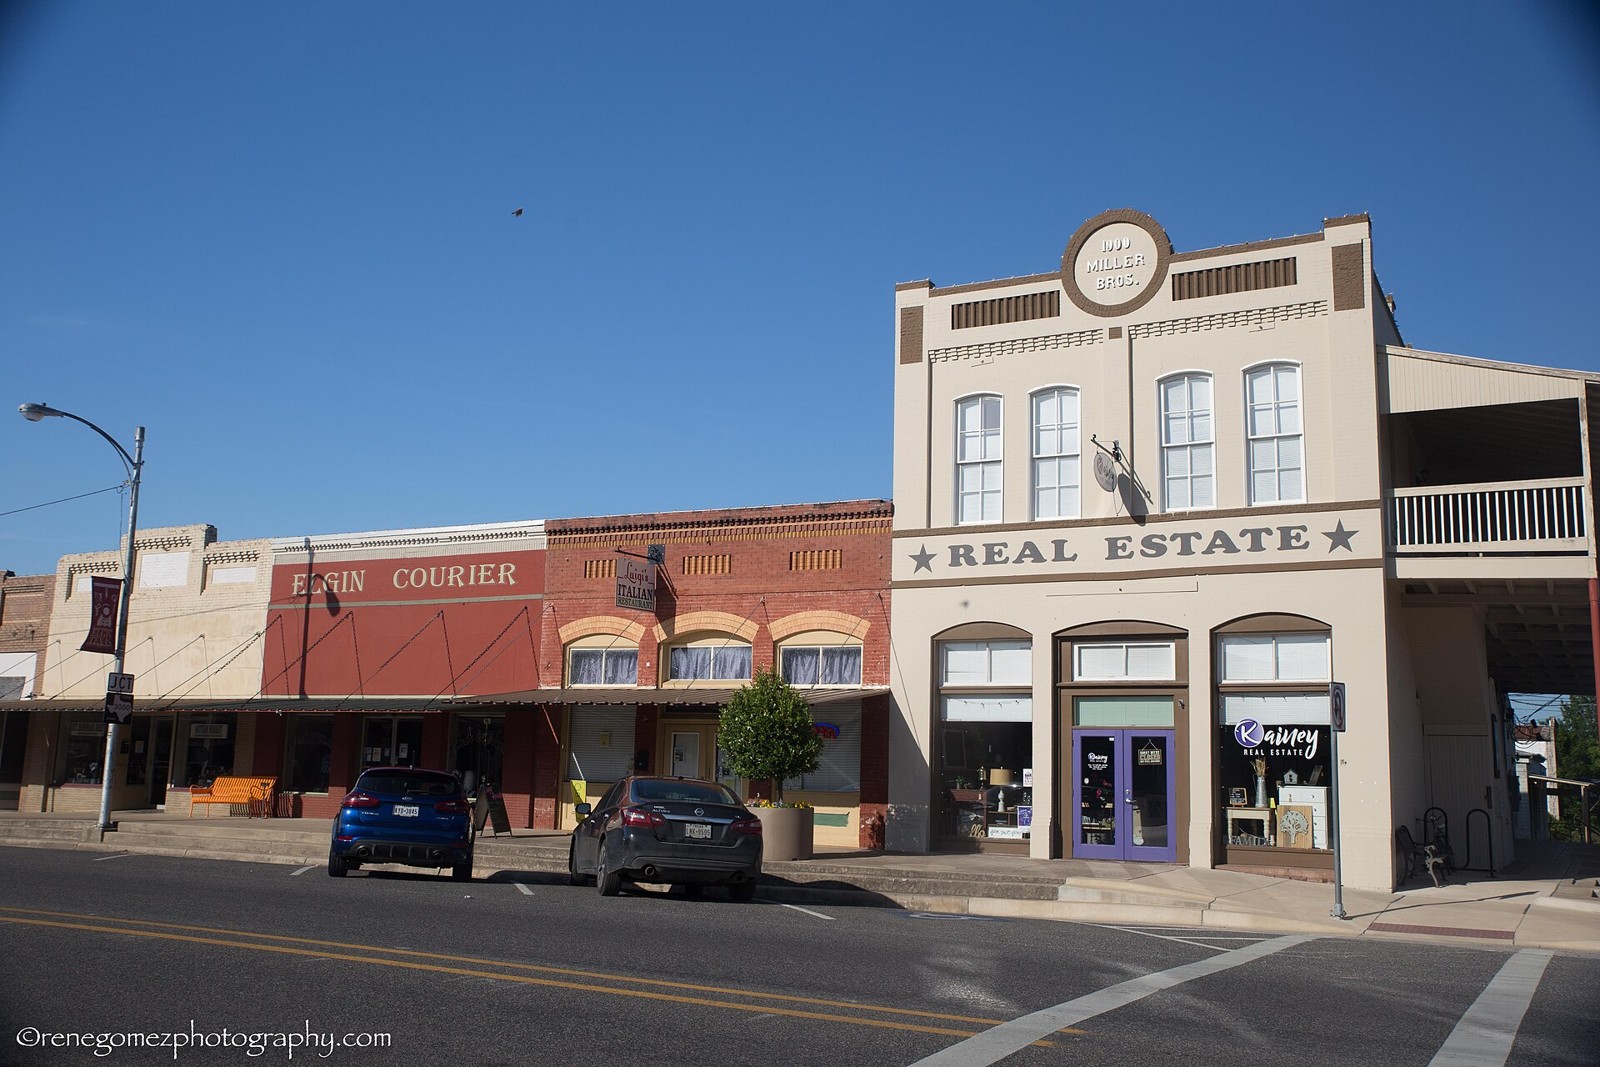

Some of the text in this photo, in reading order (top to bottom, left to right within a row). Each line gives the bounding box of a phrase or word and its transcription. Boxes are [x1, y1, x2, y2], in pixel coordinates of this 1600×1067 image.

[1086, 253, 1146, 273] MILLER
[1096, 274, 1140, 291] BROS.
[948, 524, 1310, 568] REAL ESTATE
[292, 562, 517, 596] ELGIN COURIER
[624, 562, 649, 585] Luigi's
[618, 584, 653, 601] ITALIAN
[617, 597, 653, 609] RESTAURANT
[110, 676, 133, 690] JCT
[114, 703, 131, 711] 3000
[1243, 748, 1303, 756] REAL ESTATE
